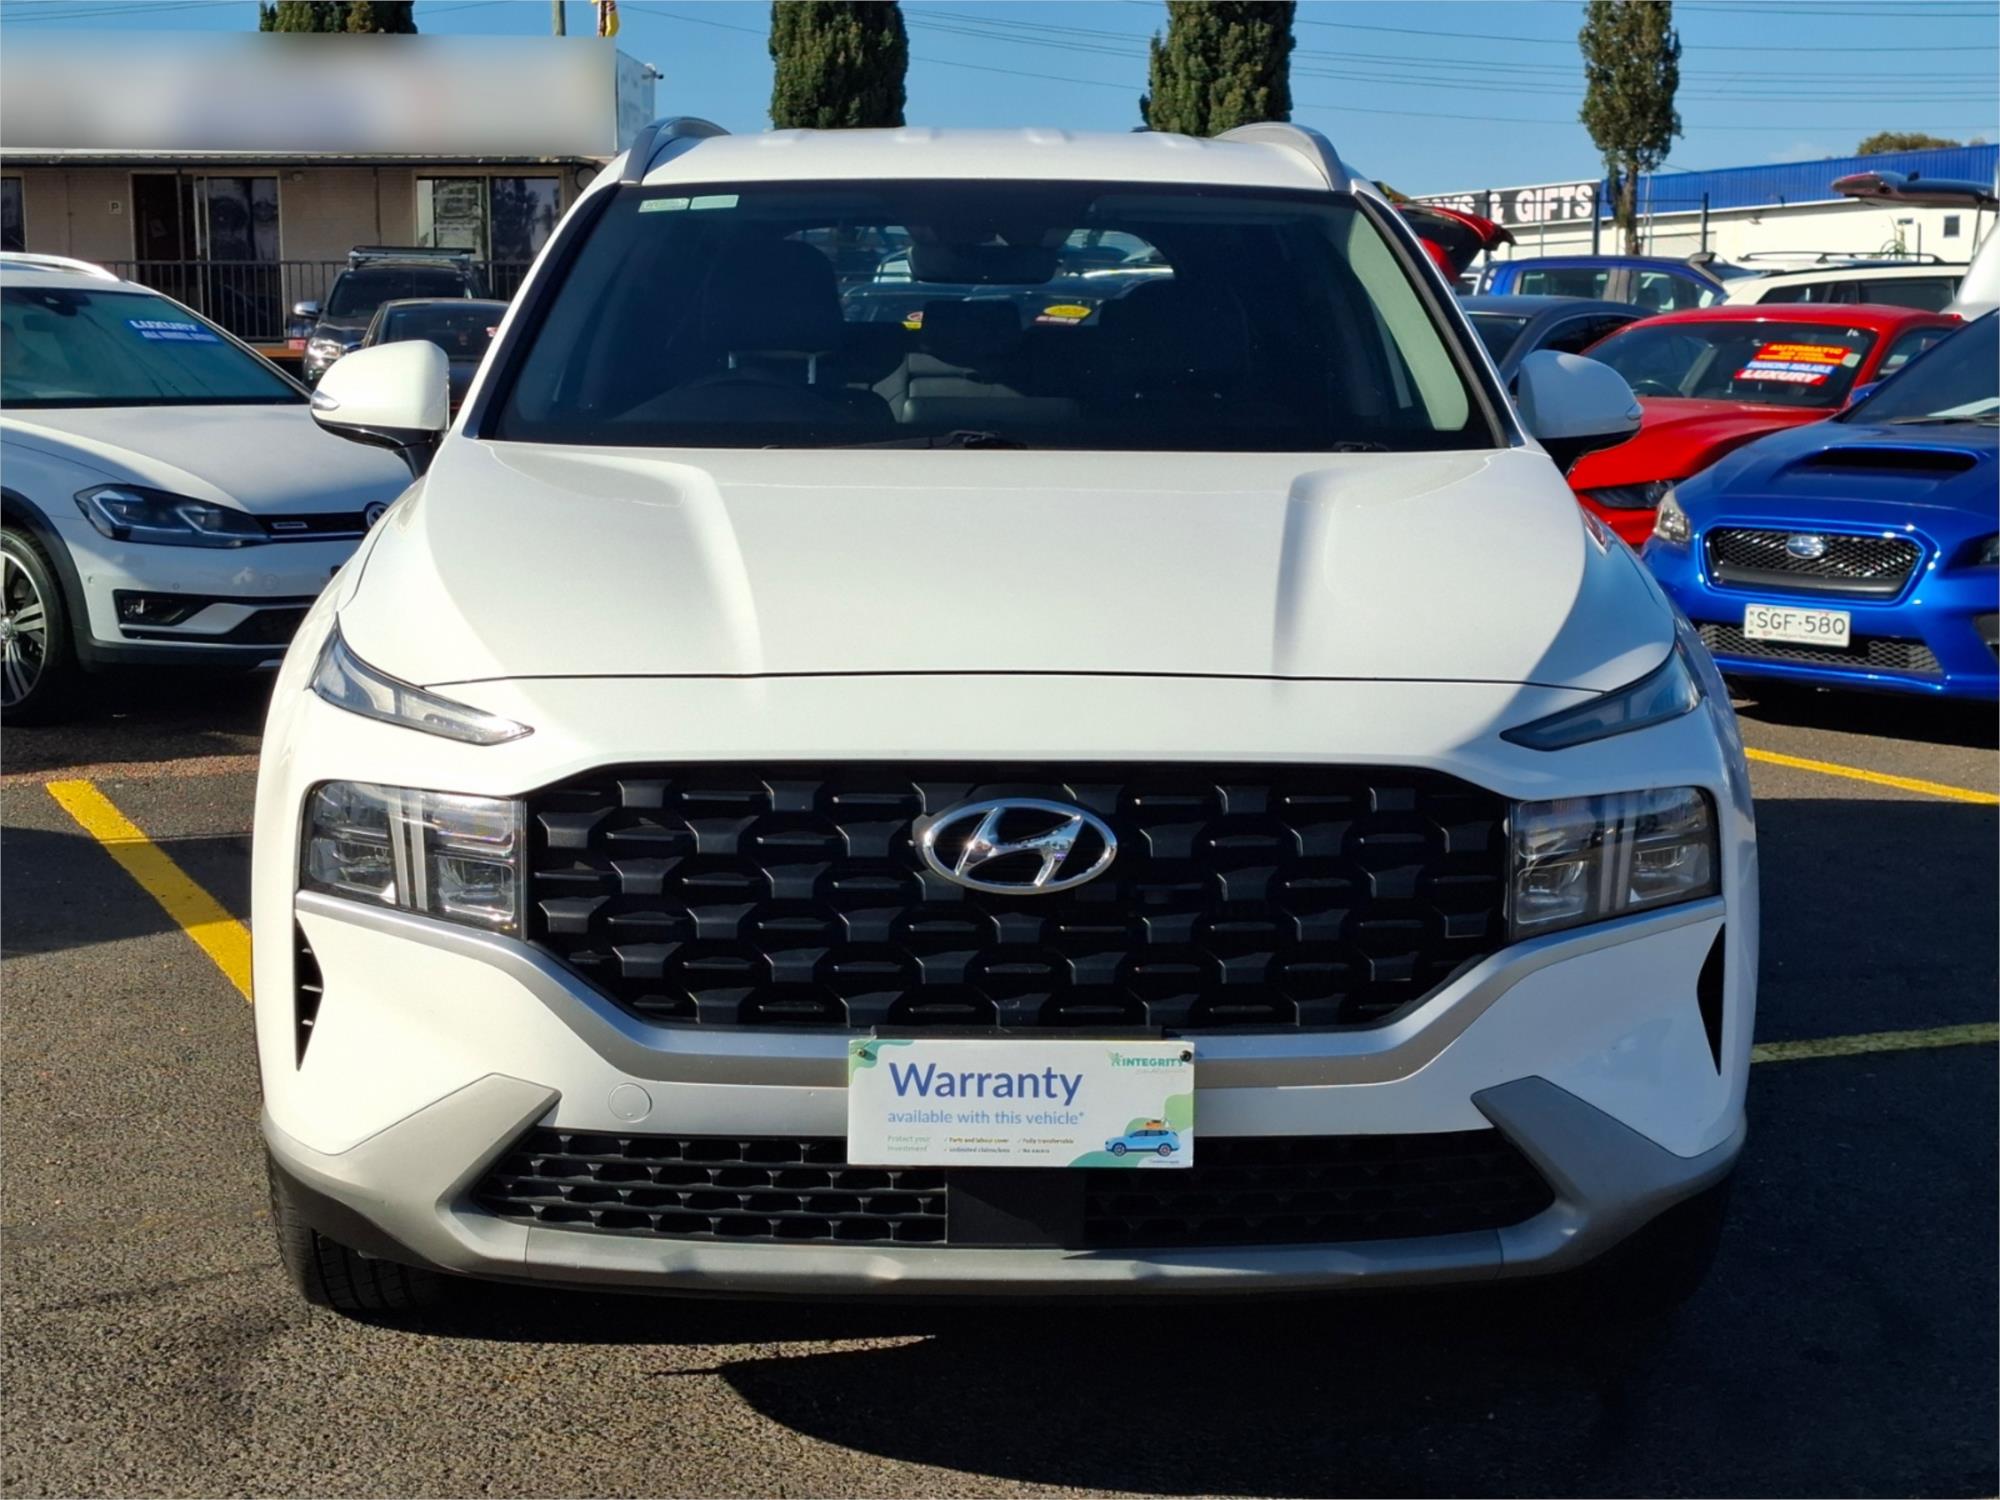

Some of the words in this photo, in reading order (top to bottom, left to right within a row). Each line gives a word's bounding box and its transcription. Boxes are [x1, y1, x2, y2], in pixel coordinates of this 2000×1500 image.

[1489, 193, 1505, 225] &
[1515, 184, 1594, 223] GIFTS
[129, 320, 198, 332] LUXURY
[1768, 344, 1844, 355] AUTOMATIC
[1740, 369, 1823, 384] LUXURY
[1122, 1057, 1184, 1067] INTEGRITY
[888, 1062, 1084, 1106] Warranty
[887, 1110, 953, 1124] available
[957, 1110, 991, 1124] with
[995, 1110, 1022, 1125] this
